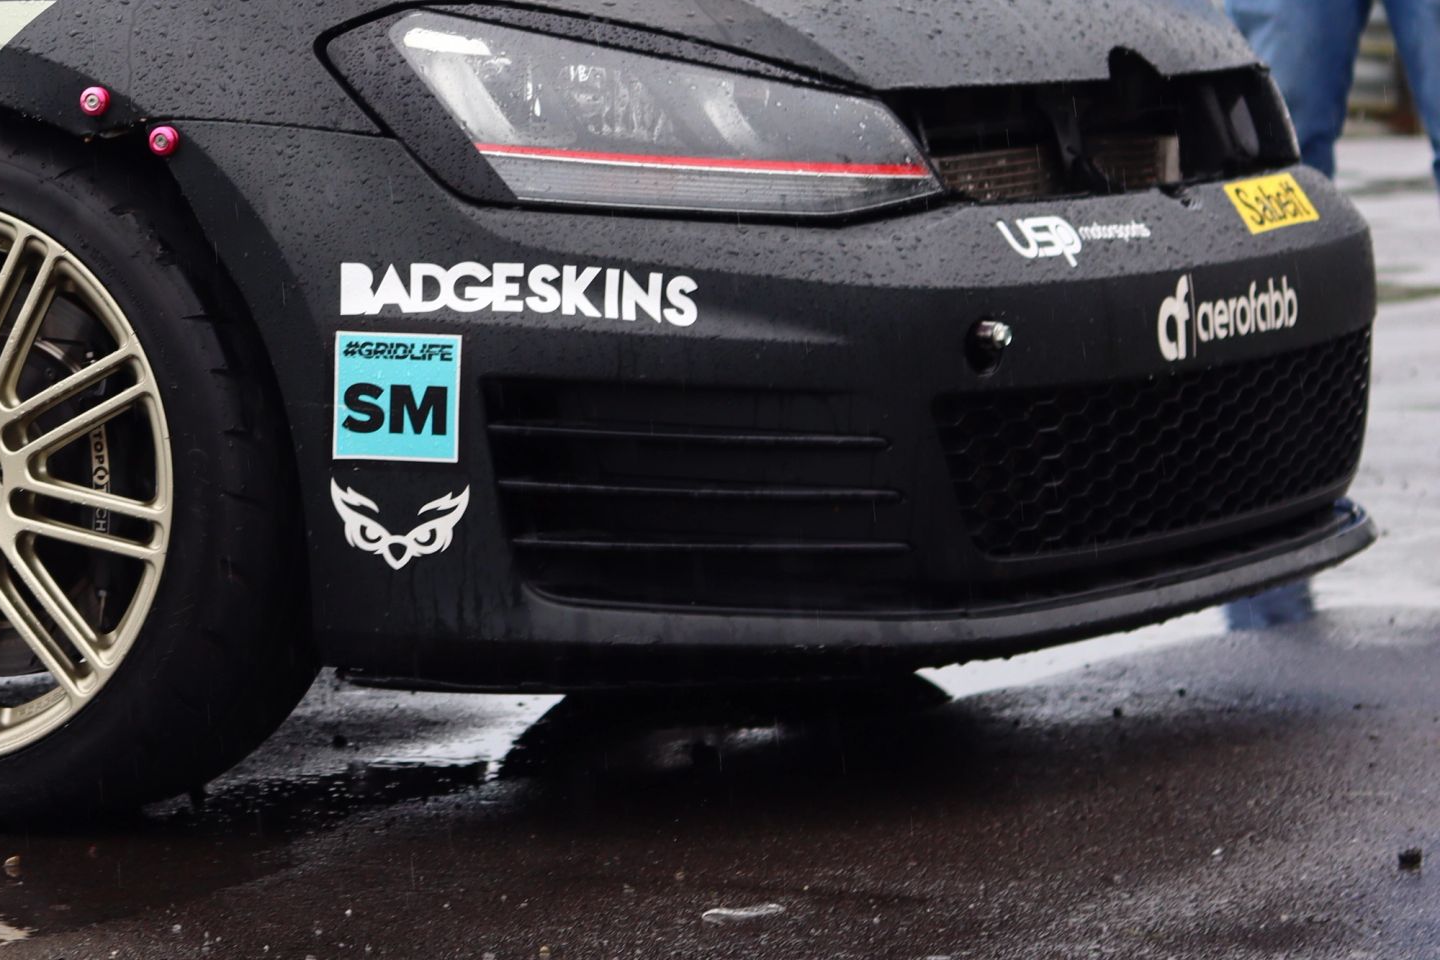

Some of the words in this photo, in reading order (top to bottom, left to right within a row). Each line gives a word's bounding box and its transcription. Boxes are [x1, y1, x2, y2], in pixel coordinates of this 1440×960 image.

[340, 261, 699, 327] BADGESKINS
[1197, 275, 1299, 342] aerofabb
[343, 341, 453, 362] #GRIDLIFE
[342, 383, 448, 436] SM
